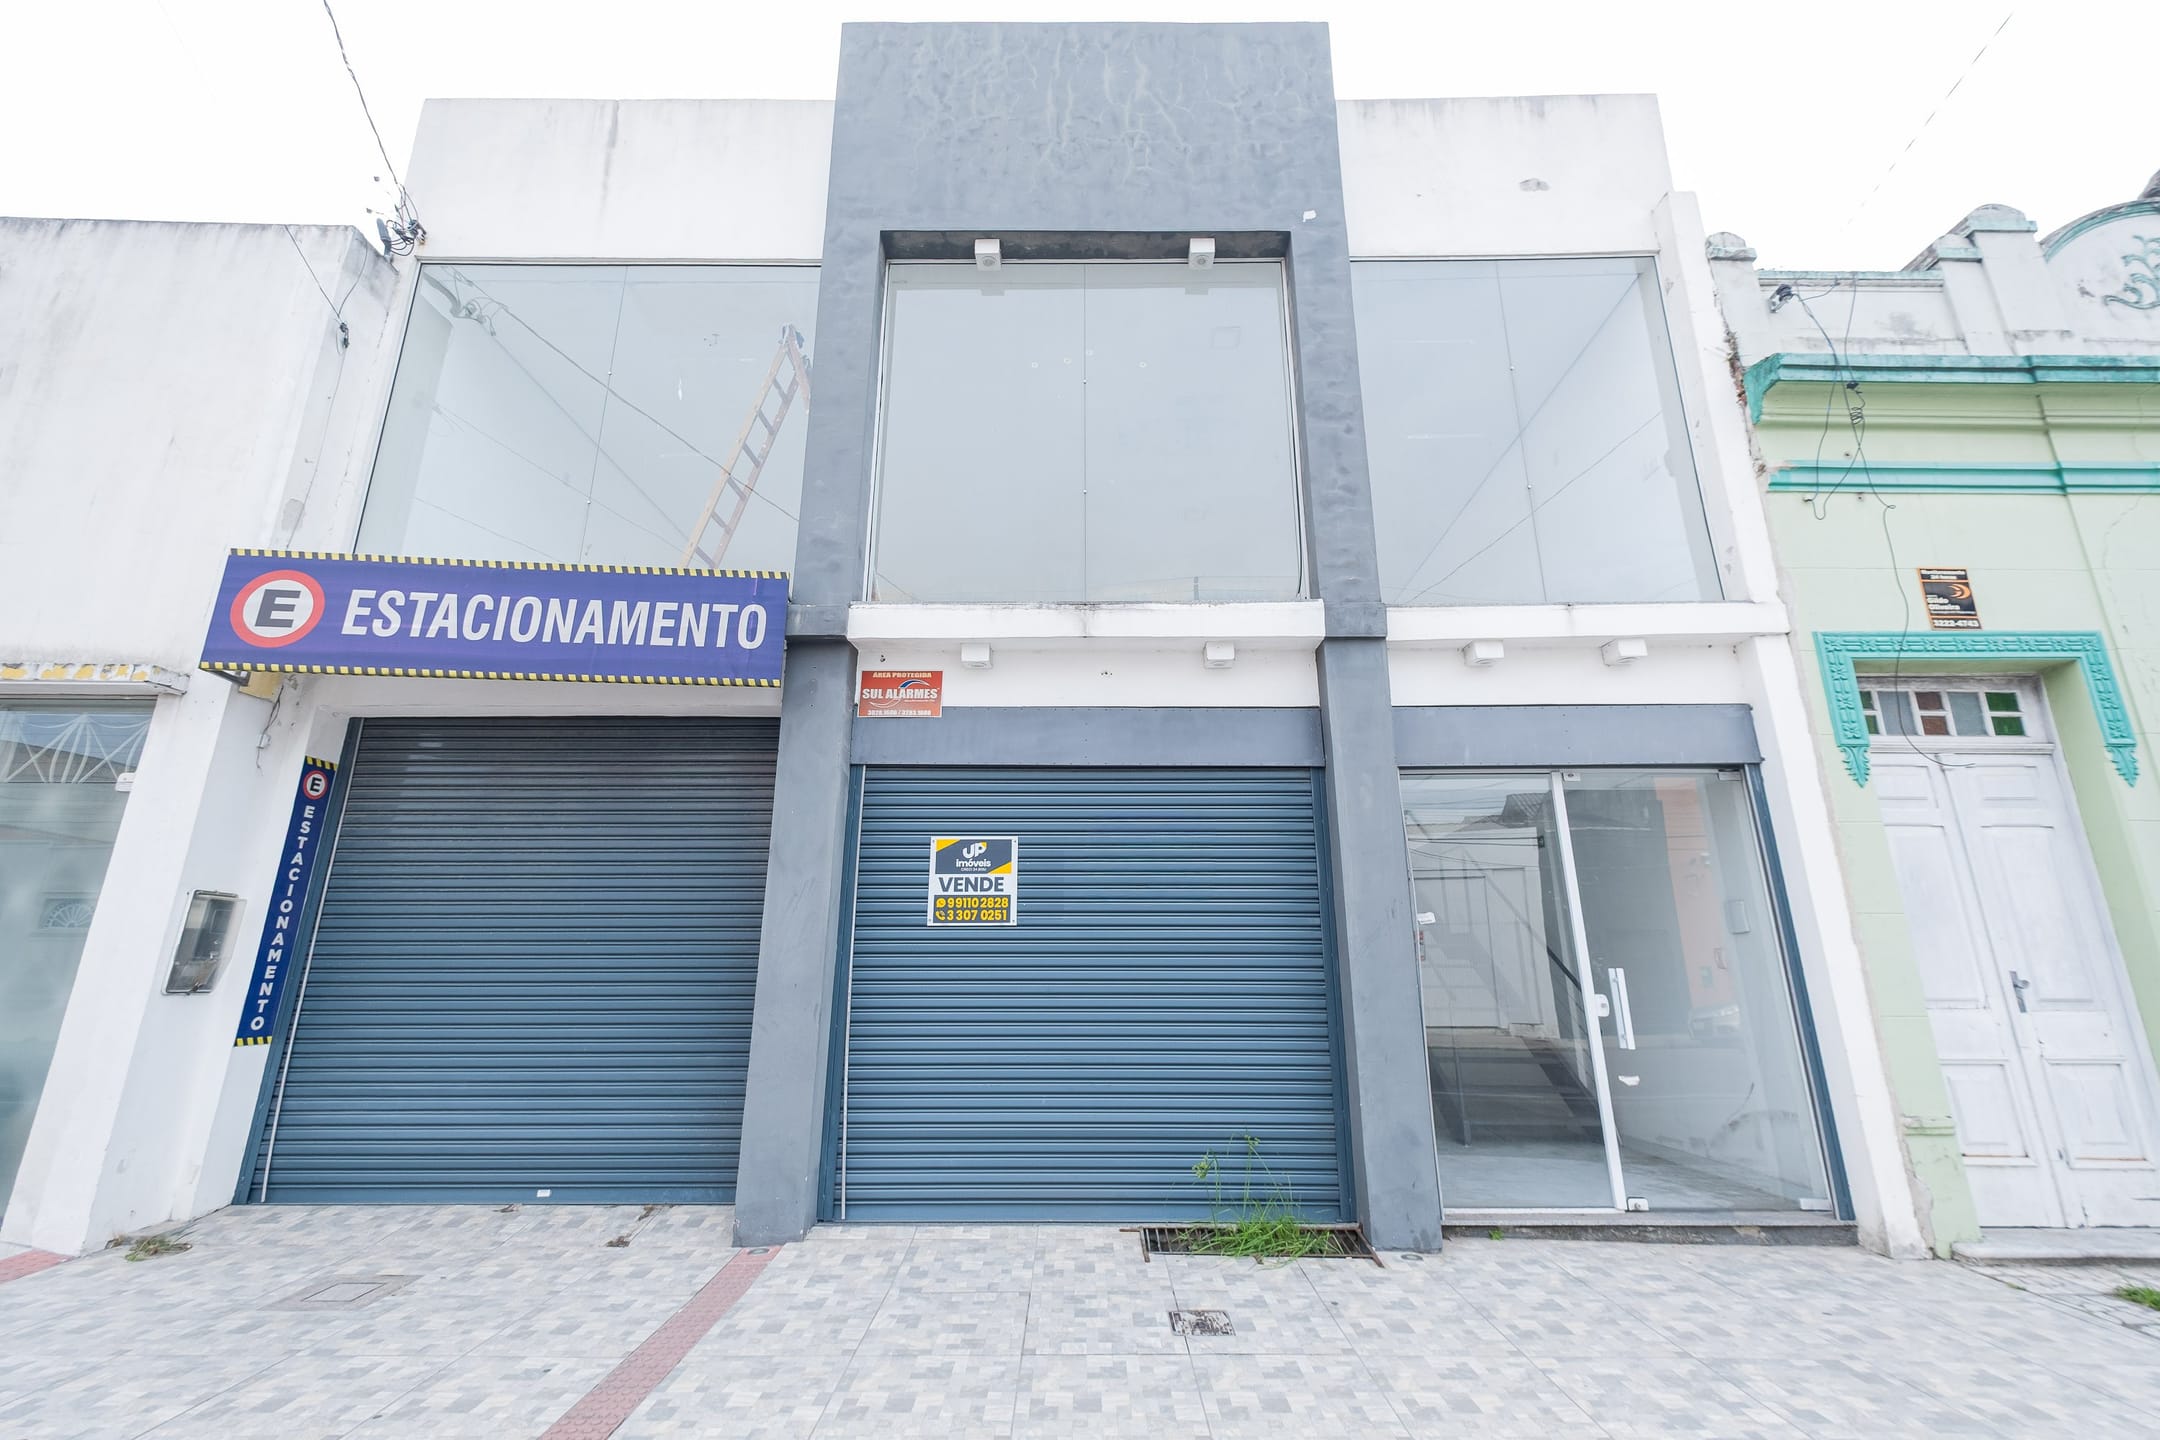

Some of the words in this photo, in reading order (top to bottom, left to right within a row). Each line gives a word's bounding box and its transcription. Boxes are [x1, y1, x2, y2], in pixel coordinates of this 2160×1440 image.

[254, 589, 301, 628] E
[341, 589, 767, 649] ESTACIONAMENTO
[862, 688, 884, 699] SUL
[885, 688, 938, 699] ALARMES
[309, 777, 322, 793] E
[938, 877, 1005, 893] VENDE
[980, 897, 1009, 908] 2828
[250, 805, 316, 1032] ESTACIONAMENTO
[980, 909, 1007, 921] 0251
